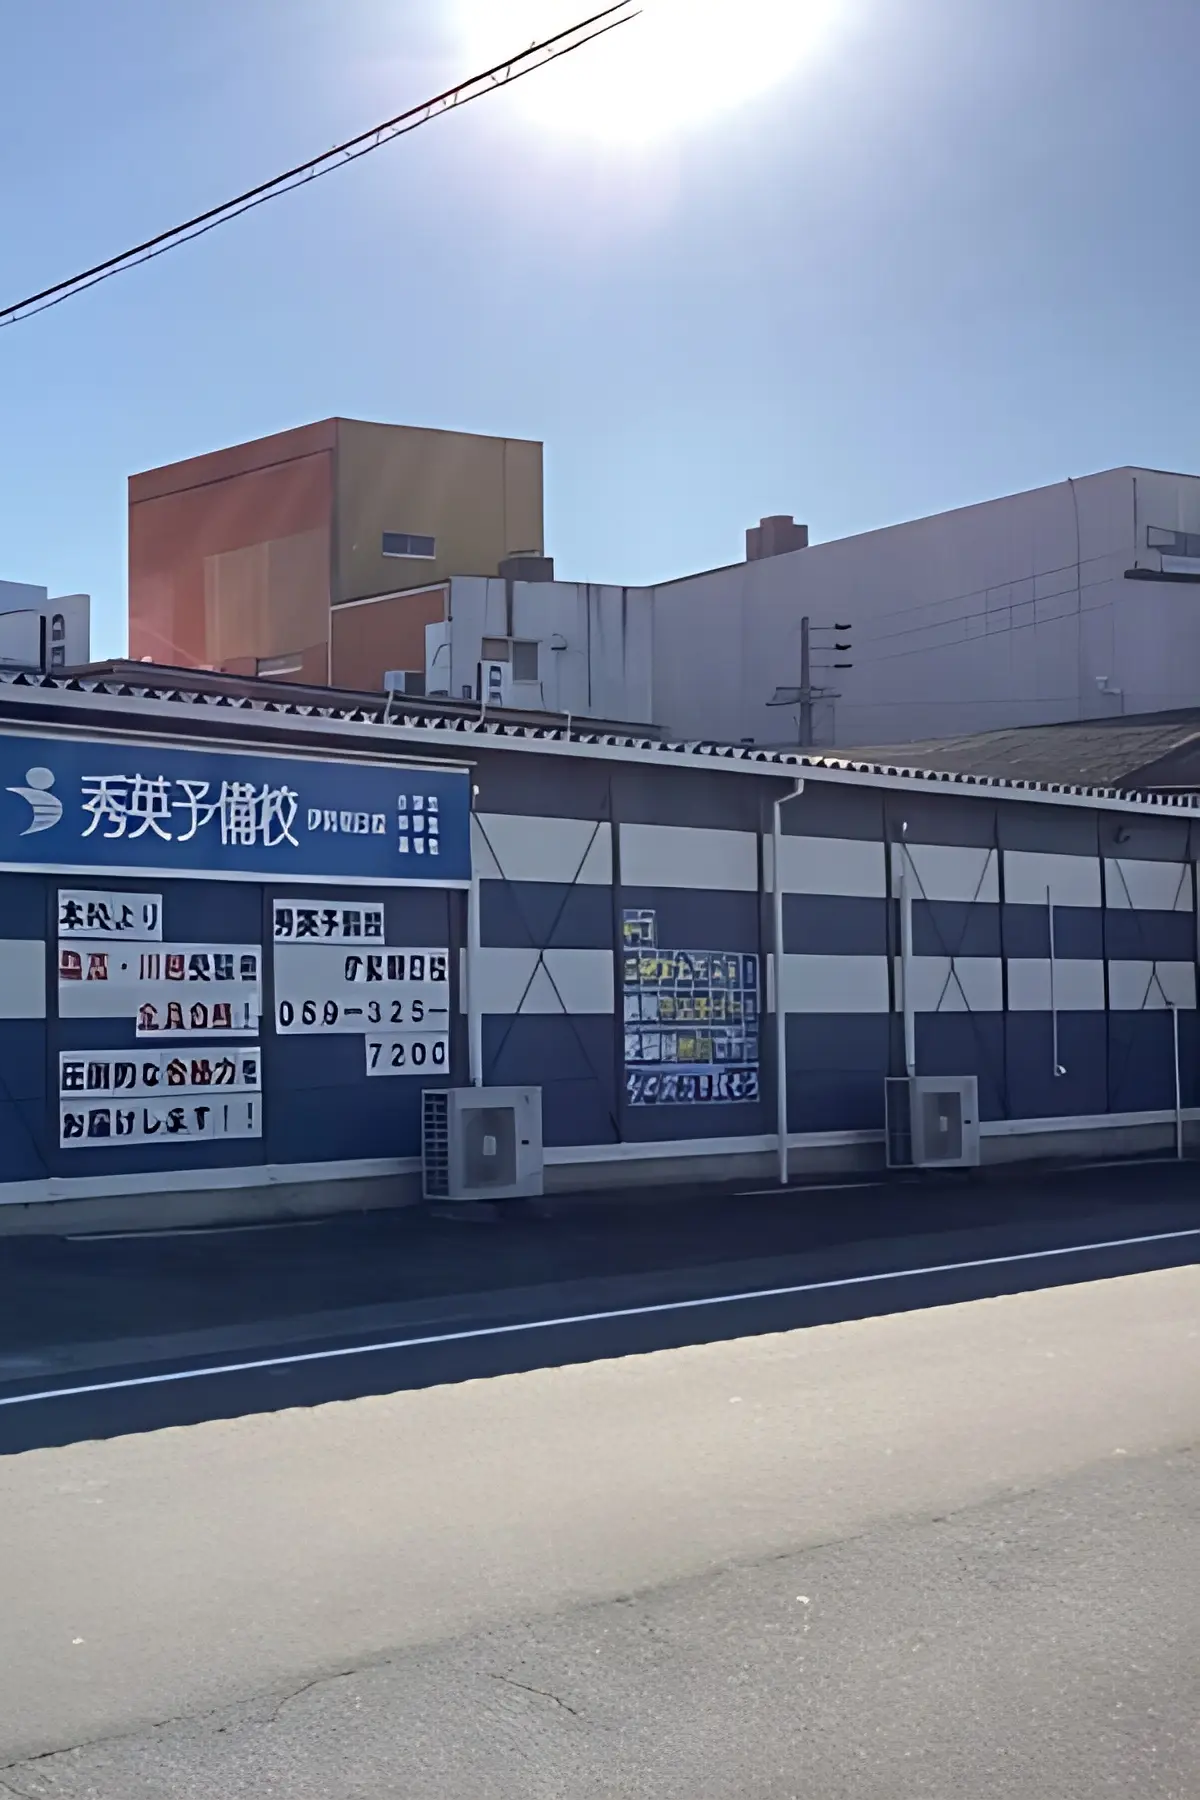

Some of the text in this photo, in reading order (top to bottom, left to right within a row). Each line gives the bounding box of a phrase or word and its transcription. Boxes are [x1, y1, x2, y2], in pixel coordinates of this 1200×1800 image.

[81, 773, 299, 847] 秀英予備校
[369, 1041, 445, 1069] 7200
